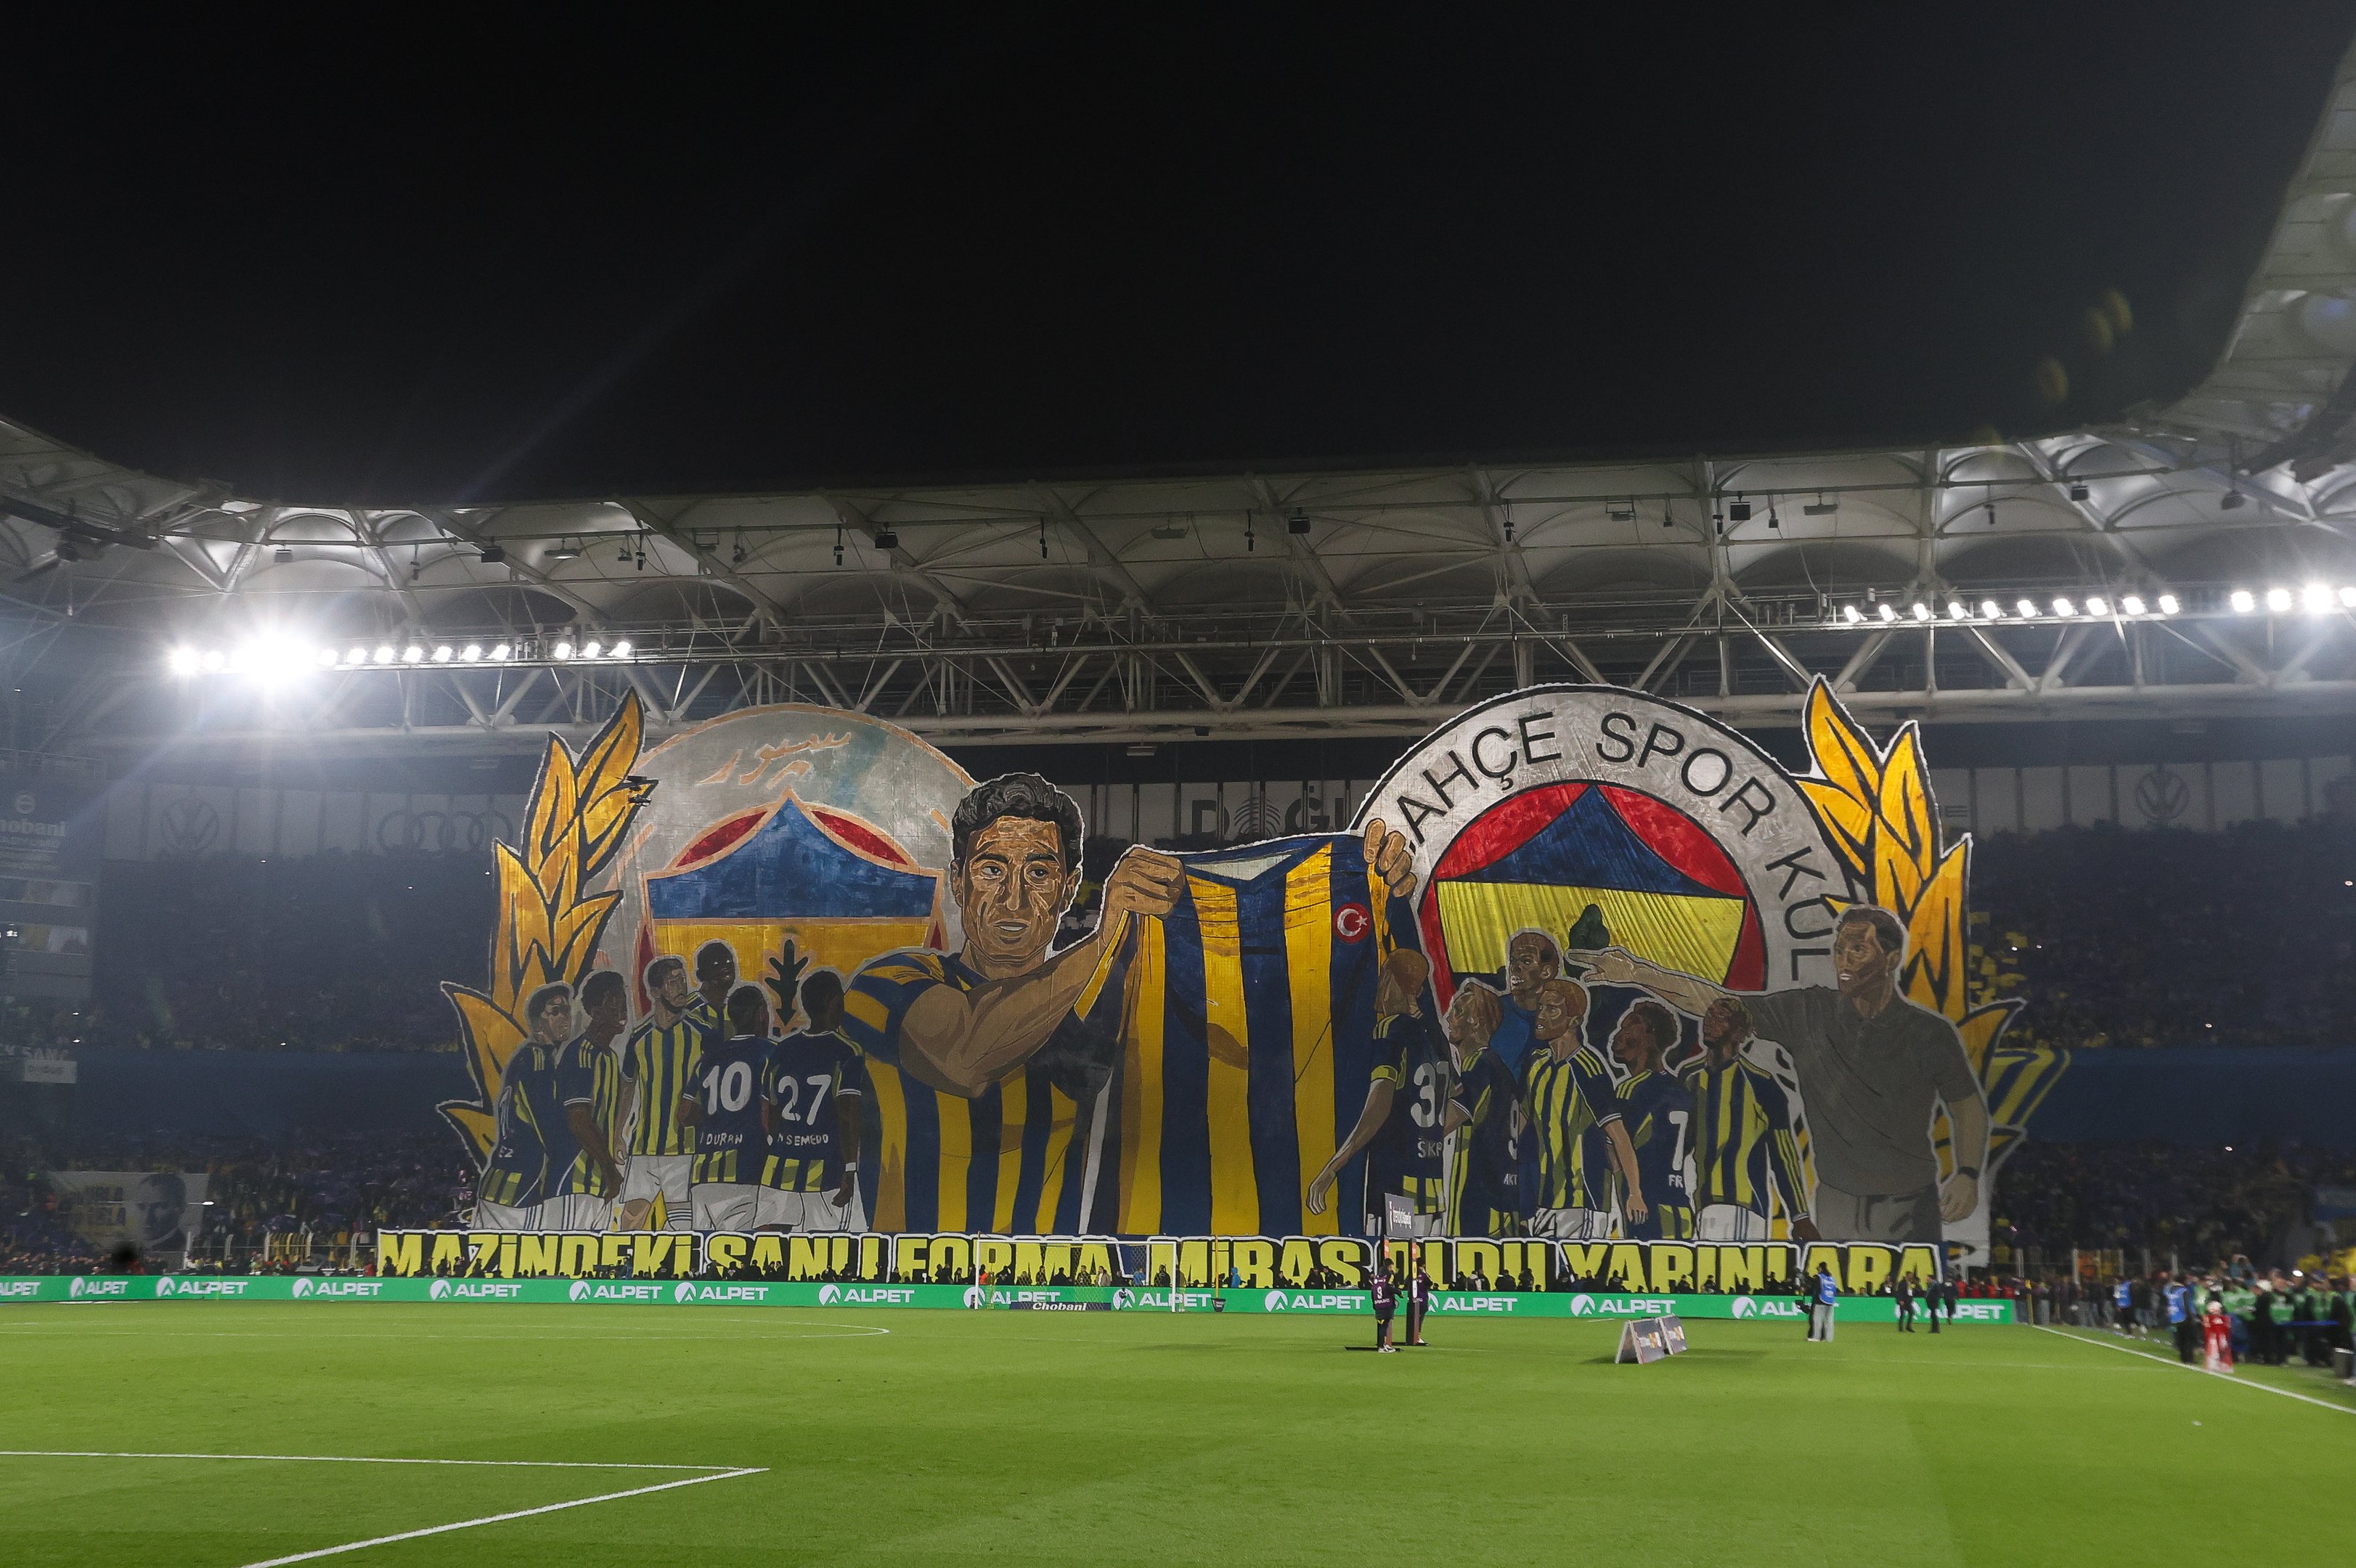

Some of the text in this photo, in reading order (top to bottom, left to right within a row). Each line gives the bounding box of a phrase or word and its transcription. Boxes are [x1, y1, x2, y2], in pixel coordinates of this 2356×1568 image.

[1397, 711, 1562, 855] AHÇE
[1596, 711, 1777, 837] SPOR
[702, 1061, 752, 1116] 10
[778, 1074, 832, 1126] 27
[786, 1133, 830, 1147] SEMEDO
[1668, 1111, 1689, 1171] 7
[86, 1281, 128, 1294] ALPET
[178, 1281, 248, 1294] ALPET
[316, 1283, 383, 1296] ALPET
[456, 1284, 521, 1297] ALPET
[594, 1286, 662, 1299] ALPET
[700, 1287, 768, 1300] ALPET
[844, 1289, 915, 1302] ALPET
[1138, 1293, 1212, 1307] ALPET
[1292, 1295, 1366, 1310] ALPET
[1032, 1302, 1088, 1312] Chobani
[1442, 1297, 1517, 1312] ALPET
[1599, 1299, 1676, 1314] ALPET
